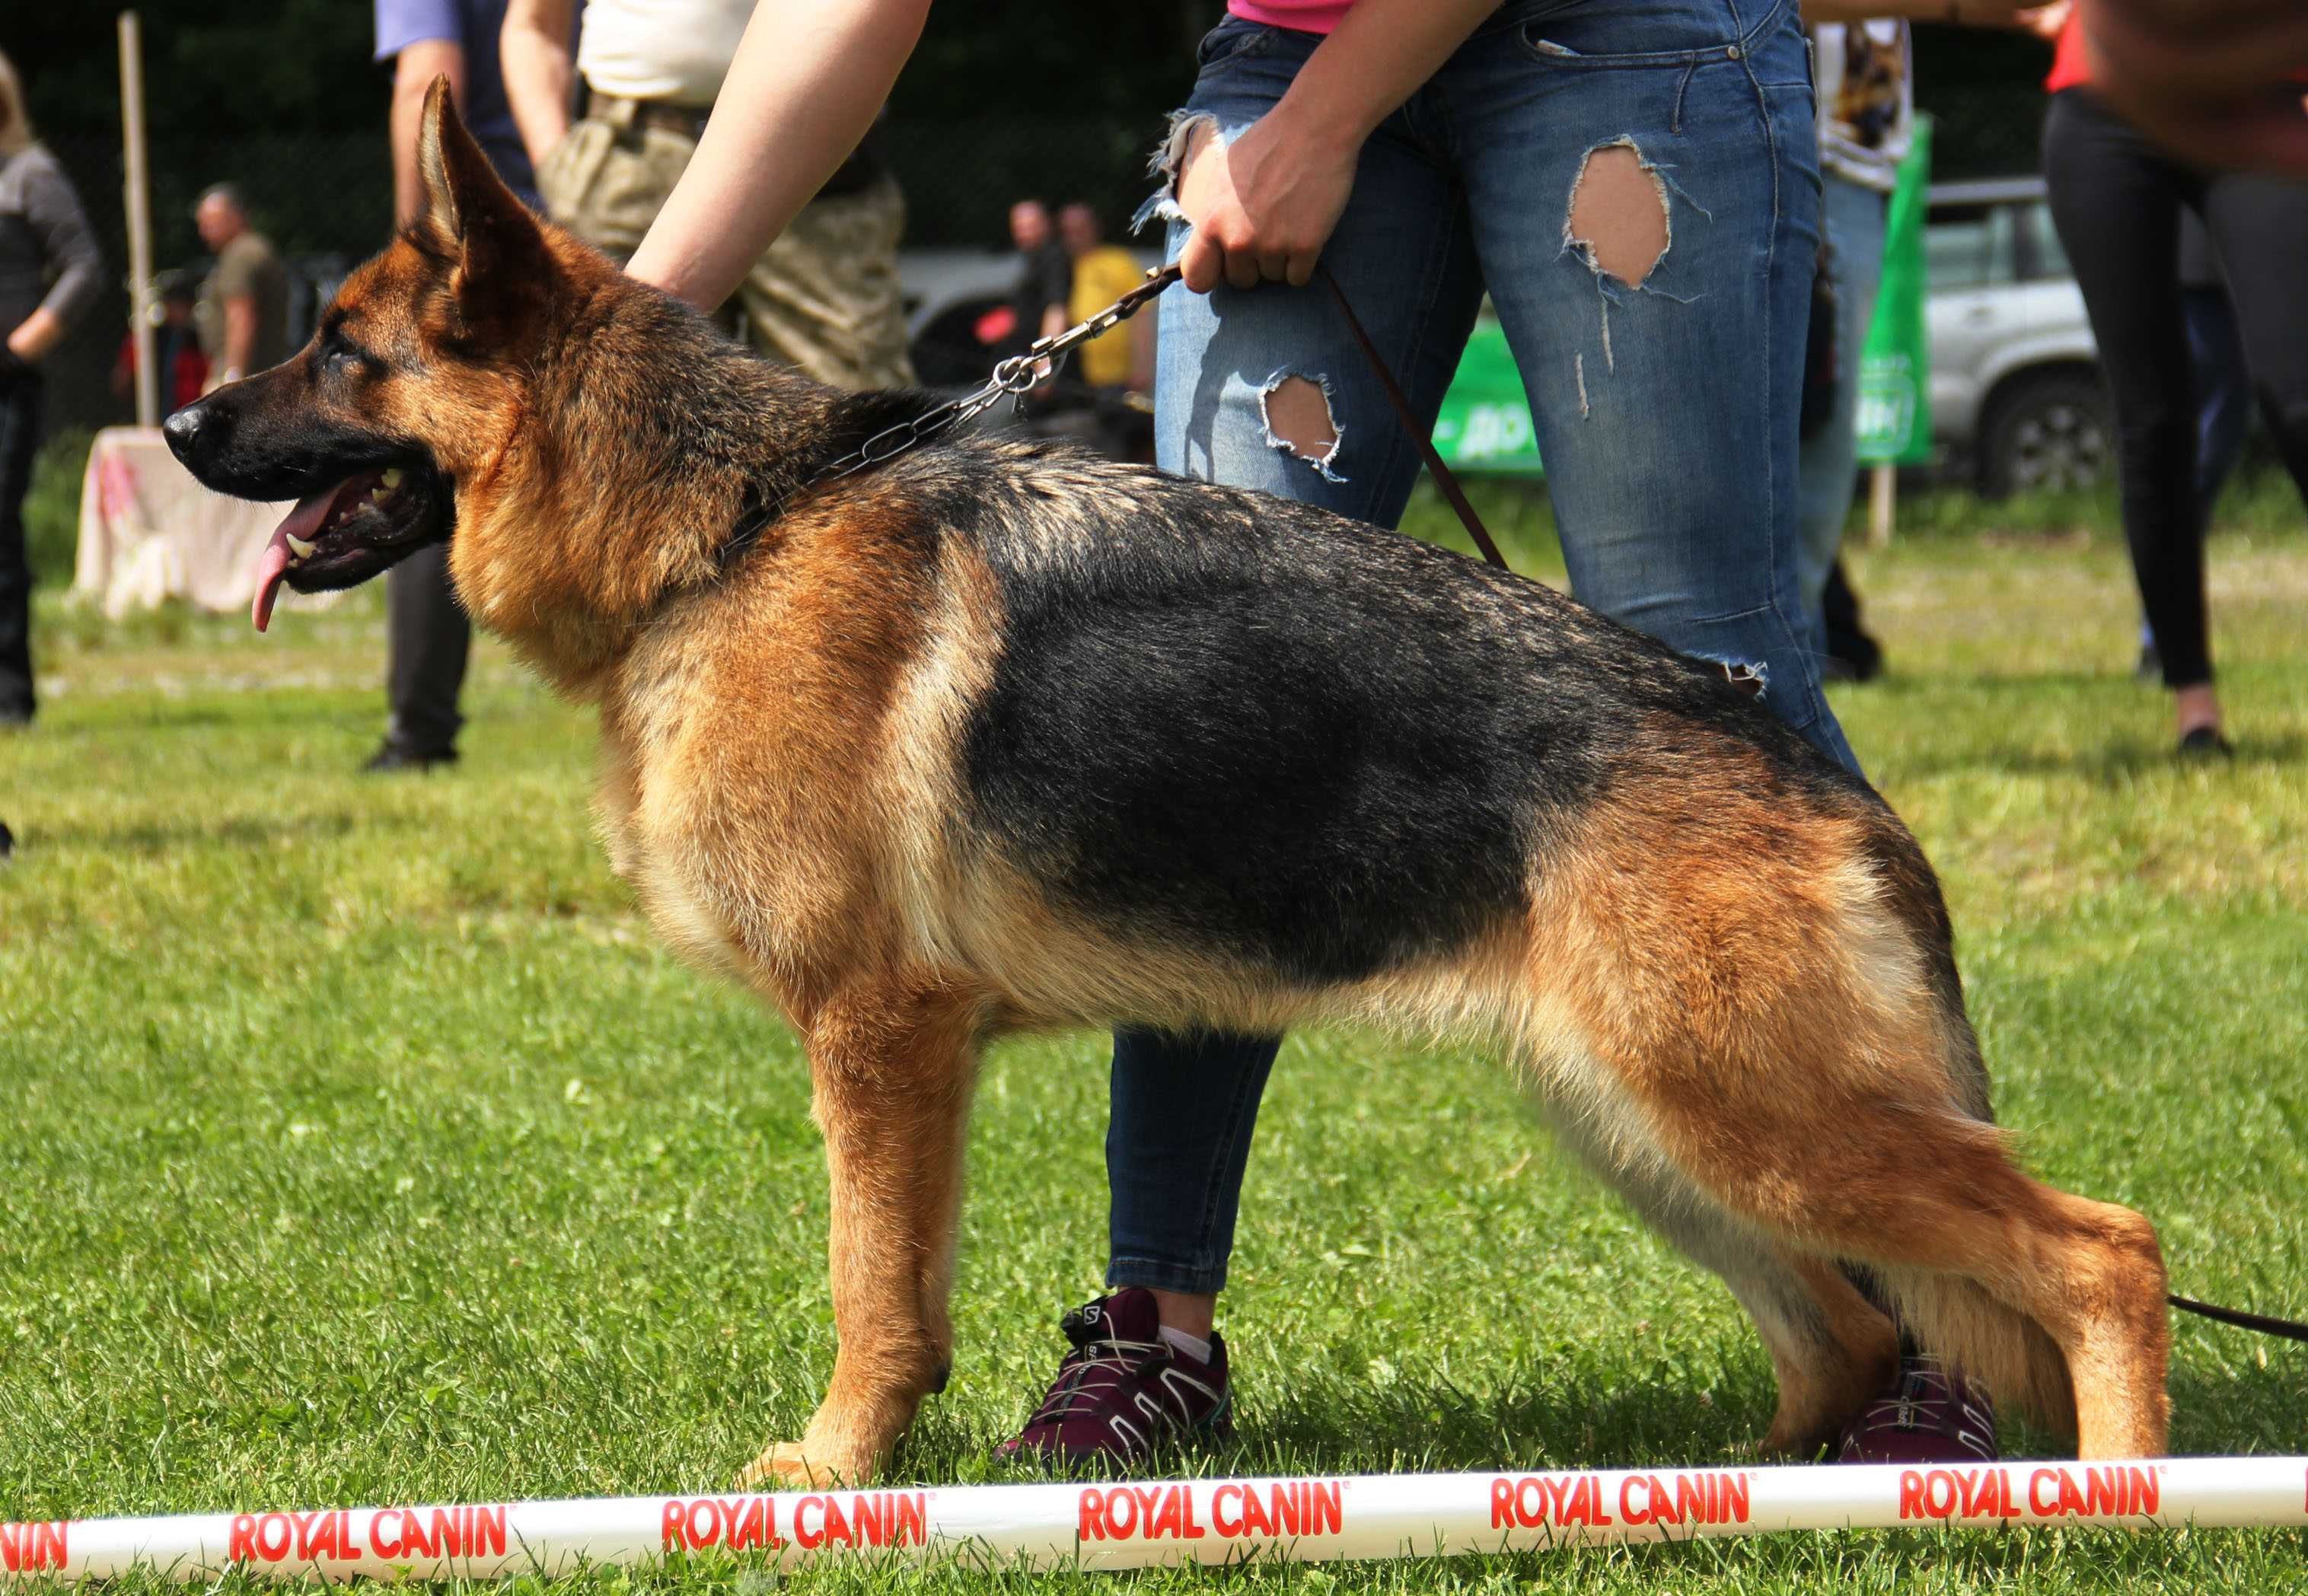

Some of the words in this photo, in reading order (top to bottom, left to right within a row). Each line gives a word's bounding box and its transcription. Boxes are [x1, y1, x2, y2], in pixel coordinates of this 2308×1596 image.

[662, 1498, 787, 1550] ROYAL
[794, 1492, 926, 1550] CANIN
[1079, 1486, 1204, 1540] ROYAL
[1212, 1481, 1342, 1538] CANIN
[1492, 1477, 1611, 1529] ROYAL
[1620, 1473, 1749, 1526] CANIN
[1900, 1469, 2021, 1519] ROYAL
[2029, 1467, 2159, 1518] CANIN
[230, 1509, 362, 1562] ROYAL
[370, 1505, 506, 1559] CANIN
